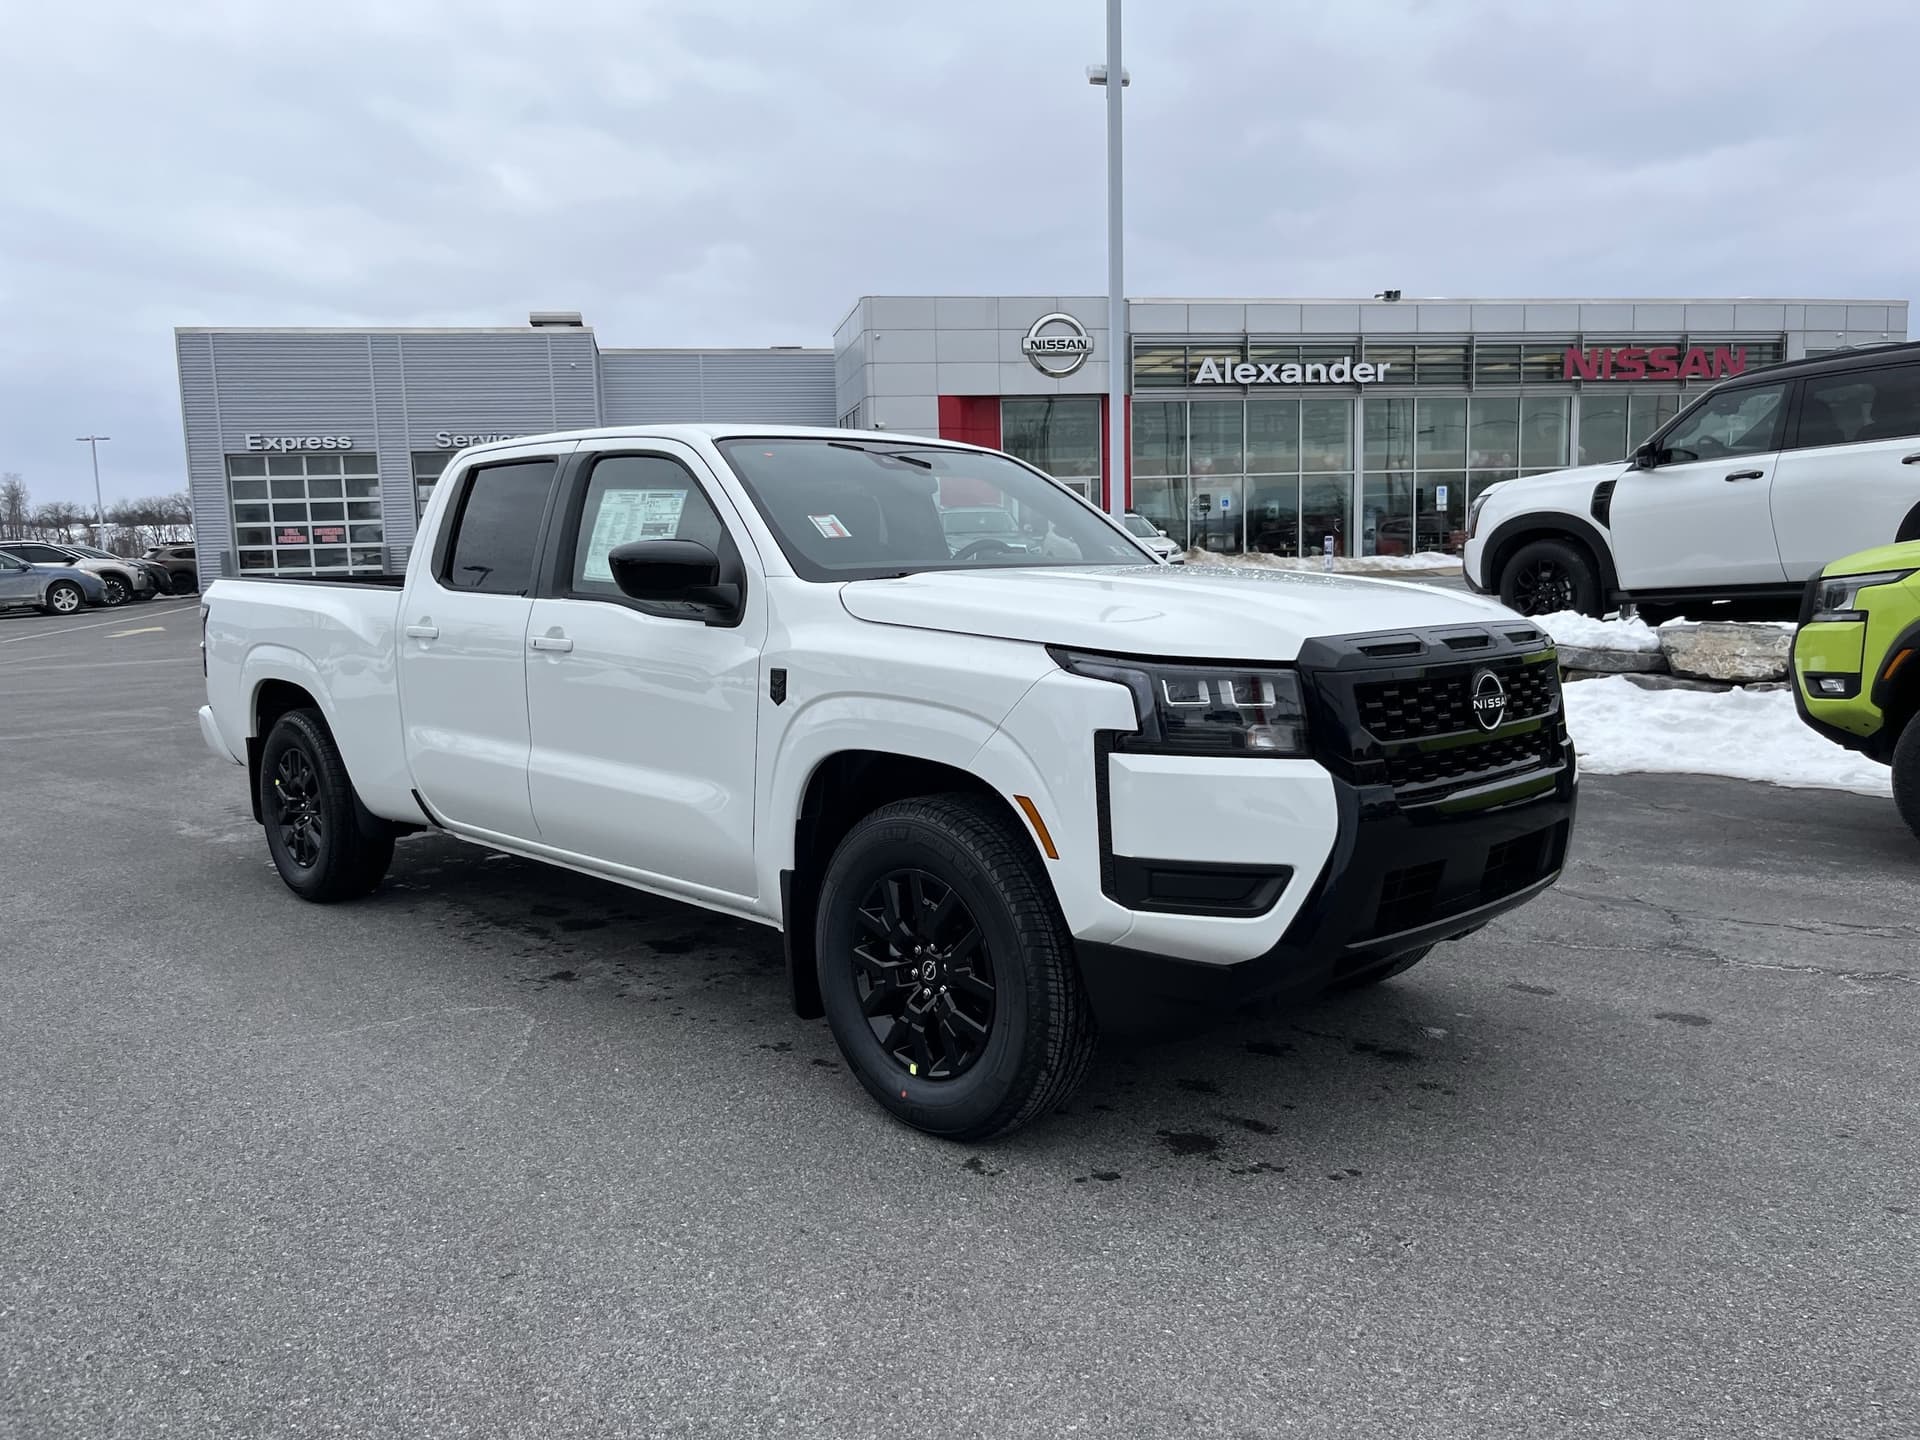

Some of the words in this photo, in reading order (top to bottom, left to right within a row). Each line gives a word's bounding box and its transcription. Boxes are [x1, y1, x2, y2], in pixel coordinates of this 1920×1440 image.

[1030, 339, 1087, 350] NISSAN
[1194, 356, 1391, 384] Alexander
[1562, 345, 1746, 380] NISSAN
[244, 433, 353, 453] Express
[436, 431, 525, 448] Servi
